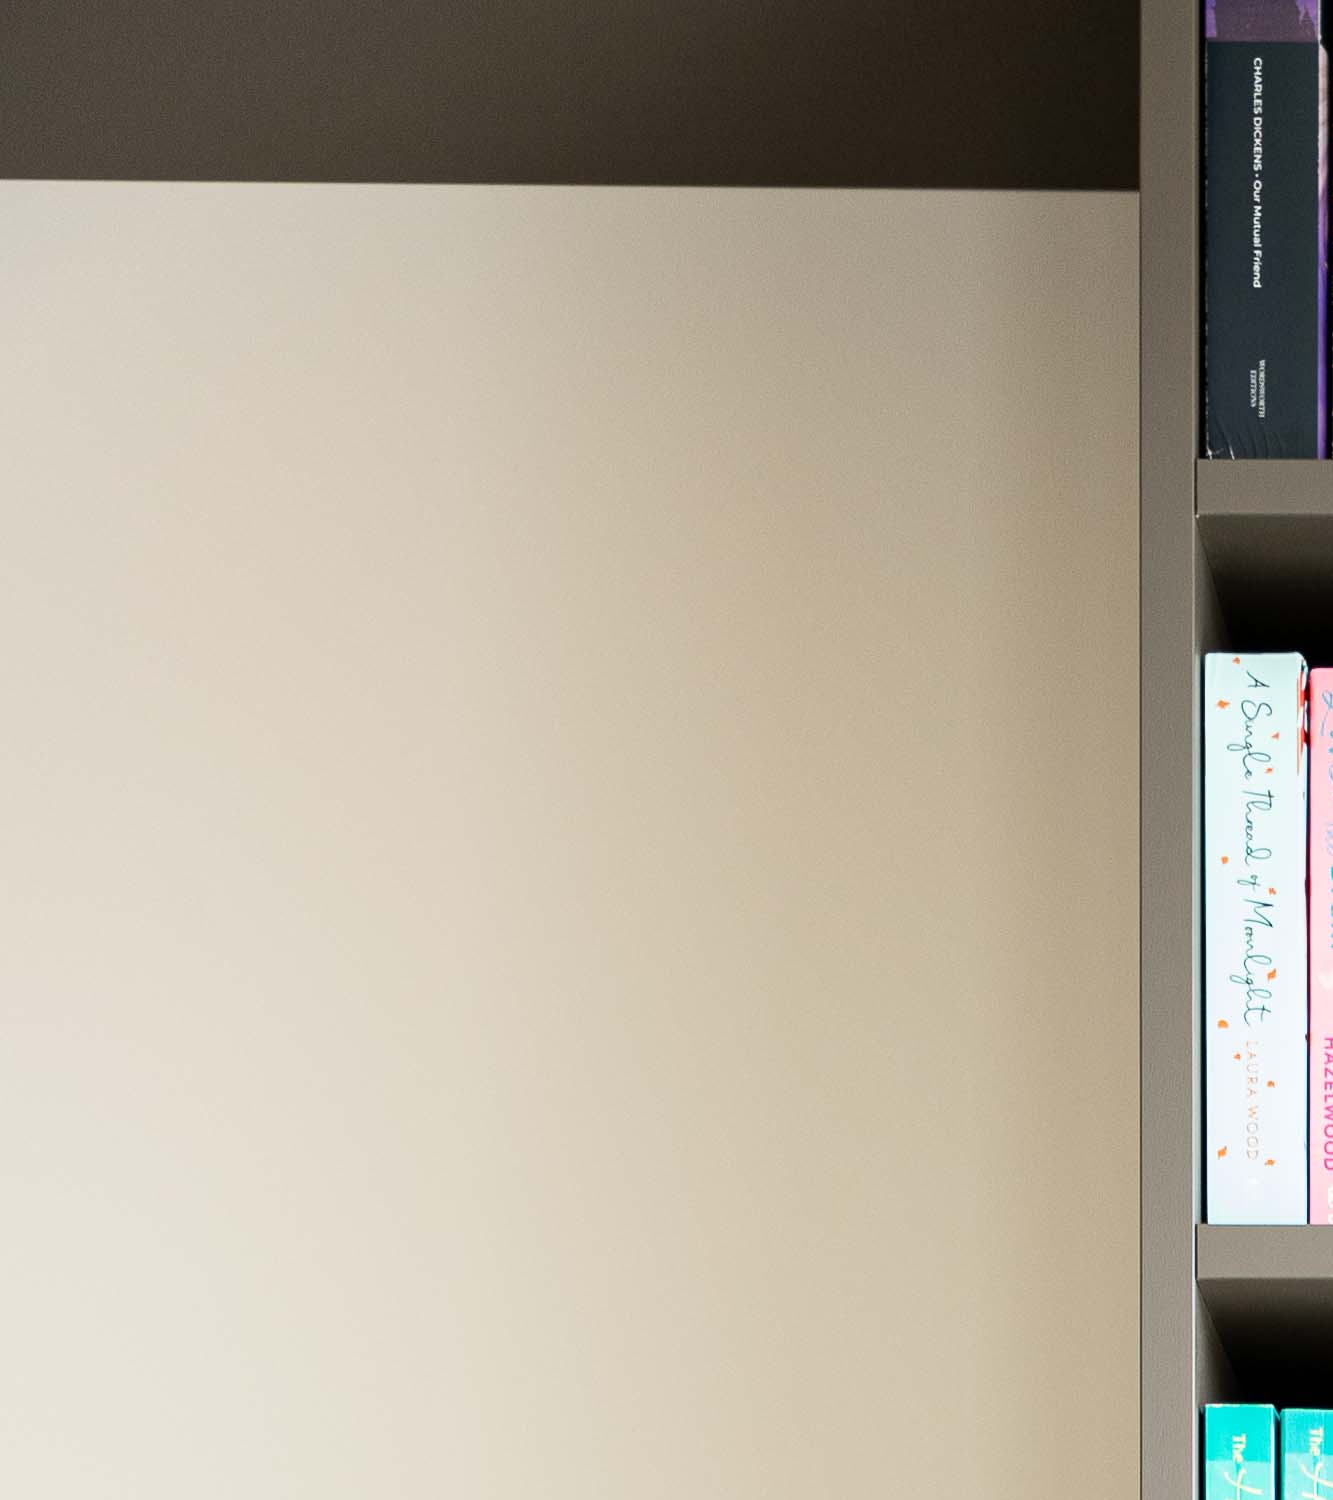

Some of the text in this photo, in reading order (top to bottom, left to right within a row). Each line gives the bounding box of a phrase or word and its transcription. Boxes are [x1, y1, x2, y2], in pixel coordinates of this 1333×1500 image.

[1253, 58, 1263, 288] CHARLES DICKENS Our Mutual Friend
